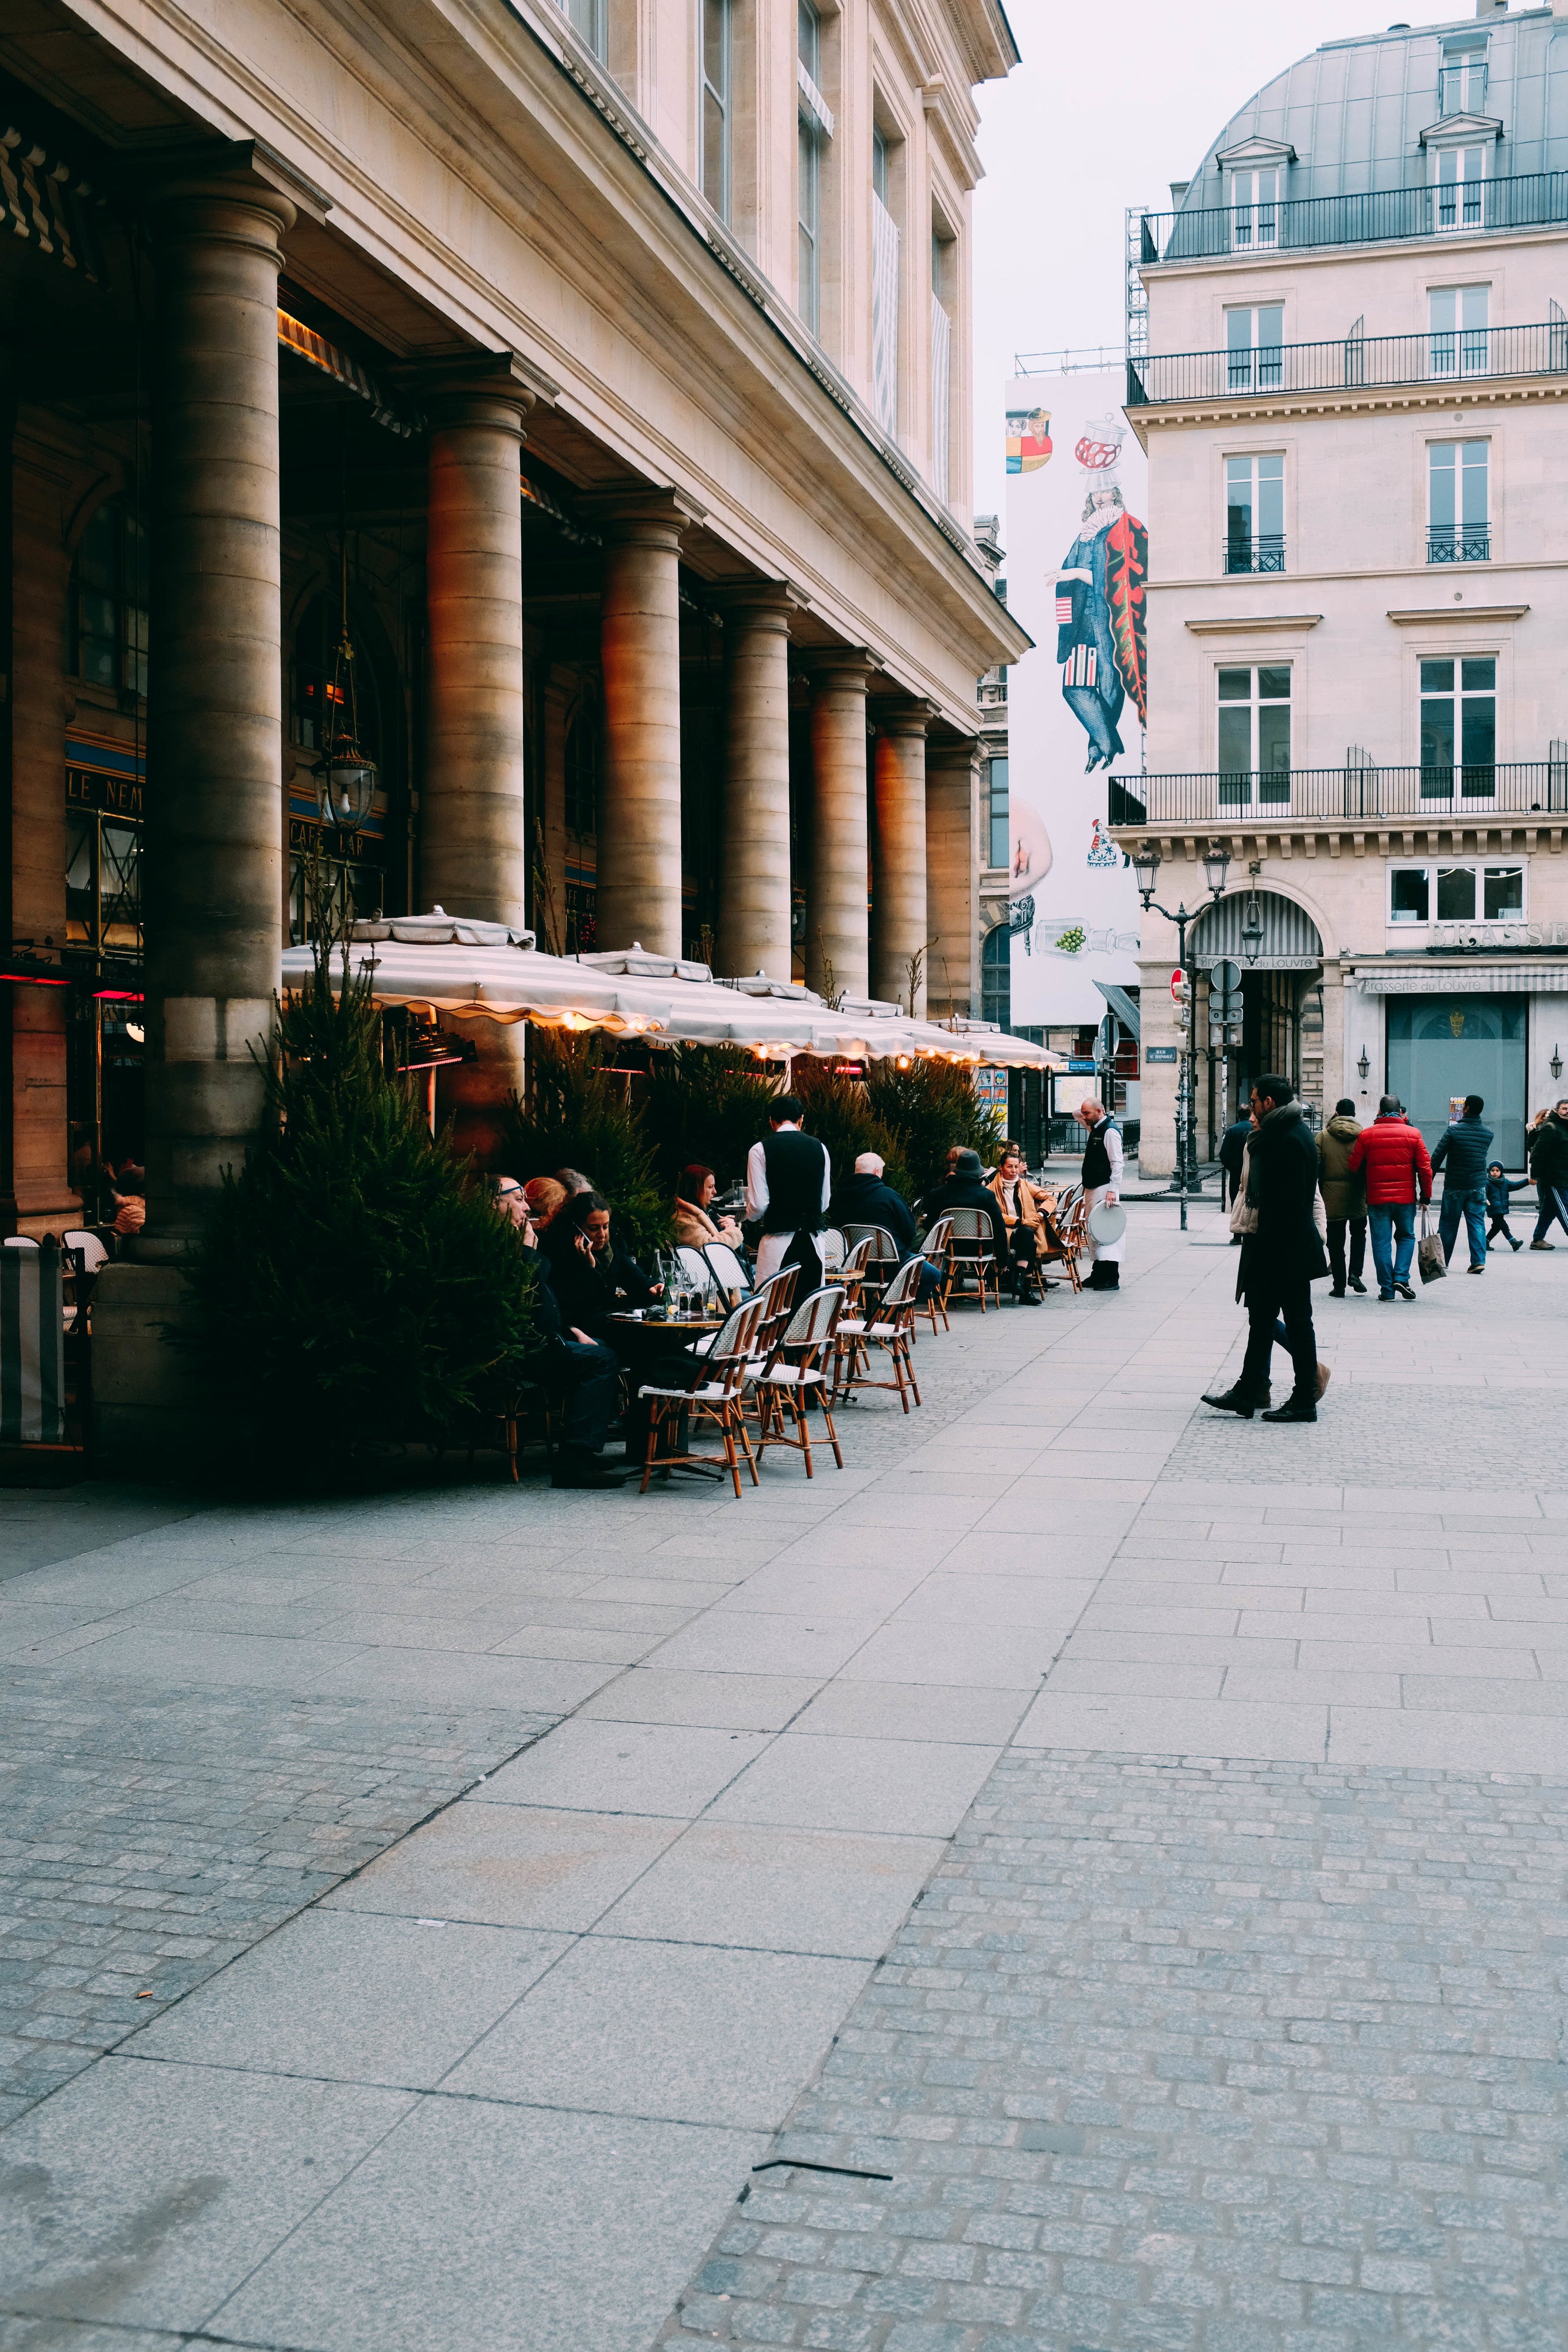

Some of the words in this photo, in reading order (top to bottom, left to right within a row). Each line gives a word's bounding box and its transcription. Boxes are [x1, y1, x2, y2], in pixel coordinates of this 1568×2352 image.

[68, 772, 90, 800] LE
[1426, 922, 1568, 947] BRASSE
[1201, 956, 1252, 968] Brarie
[1255, 960, 1269, 968] du
[1272, 957, 1313, 968] Louvre
[1365, 980, 1418, 992] Brasserie
[1421, 982, 1435, 991] du
[1438, 979, 1481, 991] Louvre
